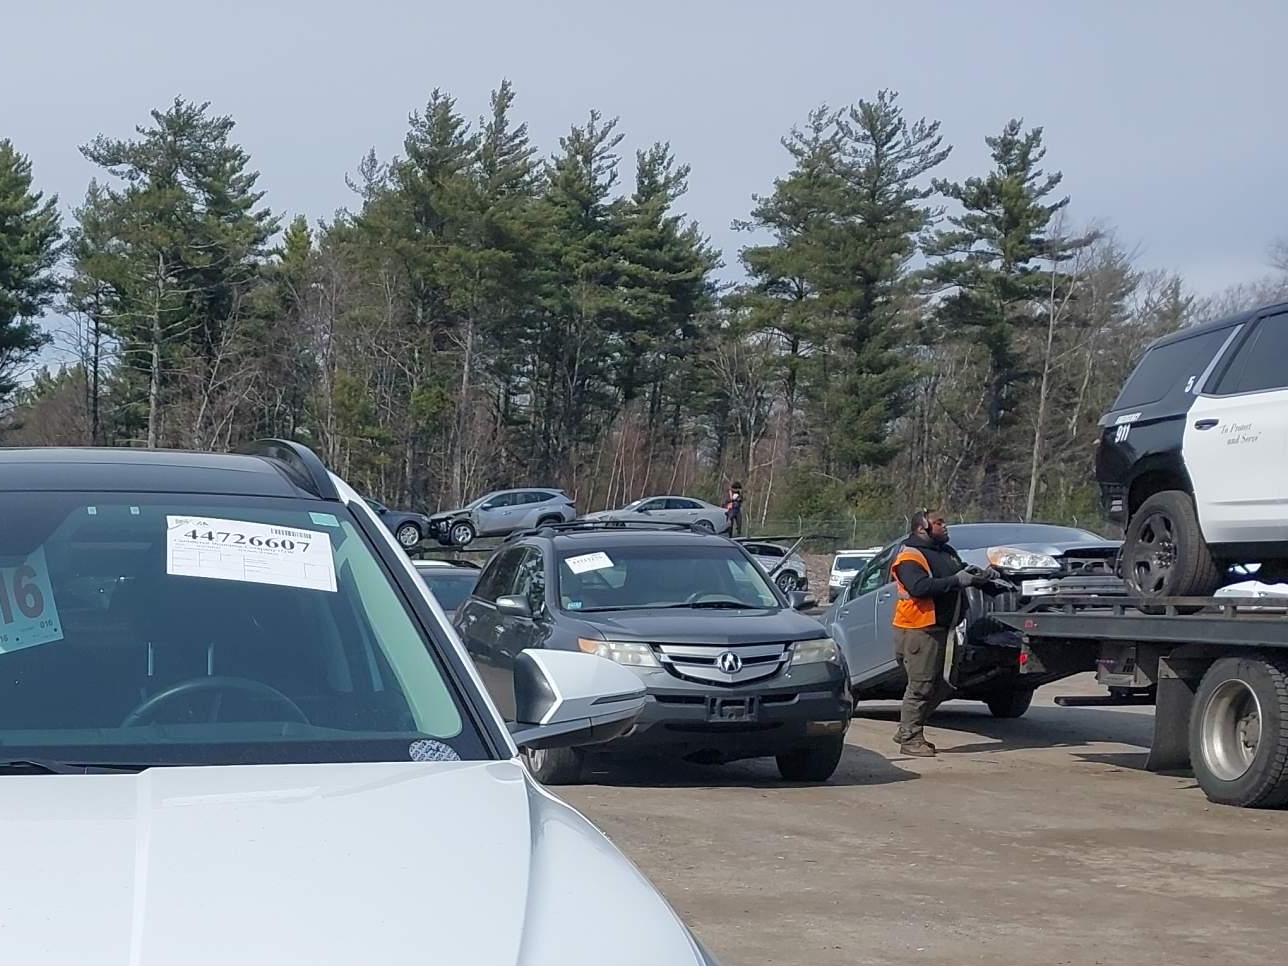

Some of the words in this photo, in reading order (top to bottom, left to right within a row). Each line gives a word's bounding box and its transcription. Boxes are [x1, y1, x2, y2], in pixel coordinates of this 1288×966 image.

[1185, 376, 1196, 392] 5
[1115, 423, 1131, 443] 911
[1230, 423, 1252, 433] Protect
[1227, 434, 1240, 445] and
[184, 529, 312, 552] 44726607
[40, 620, 53, 629] 016
